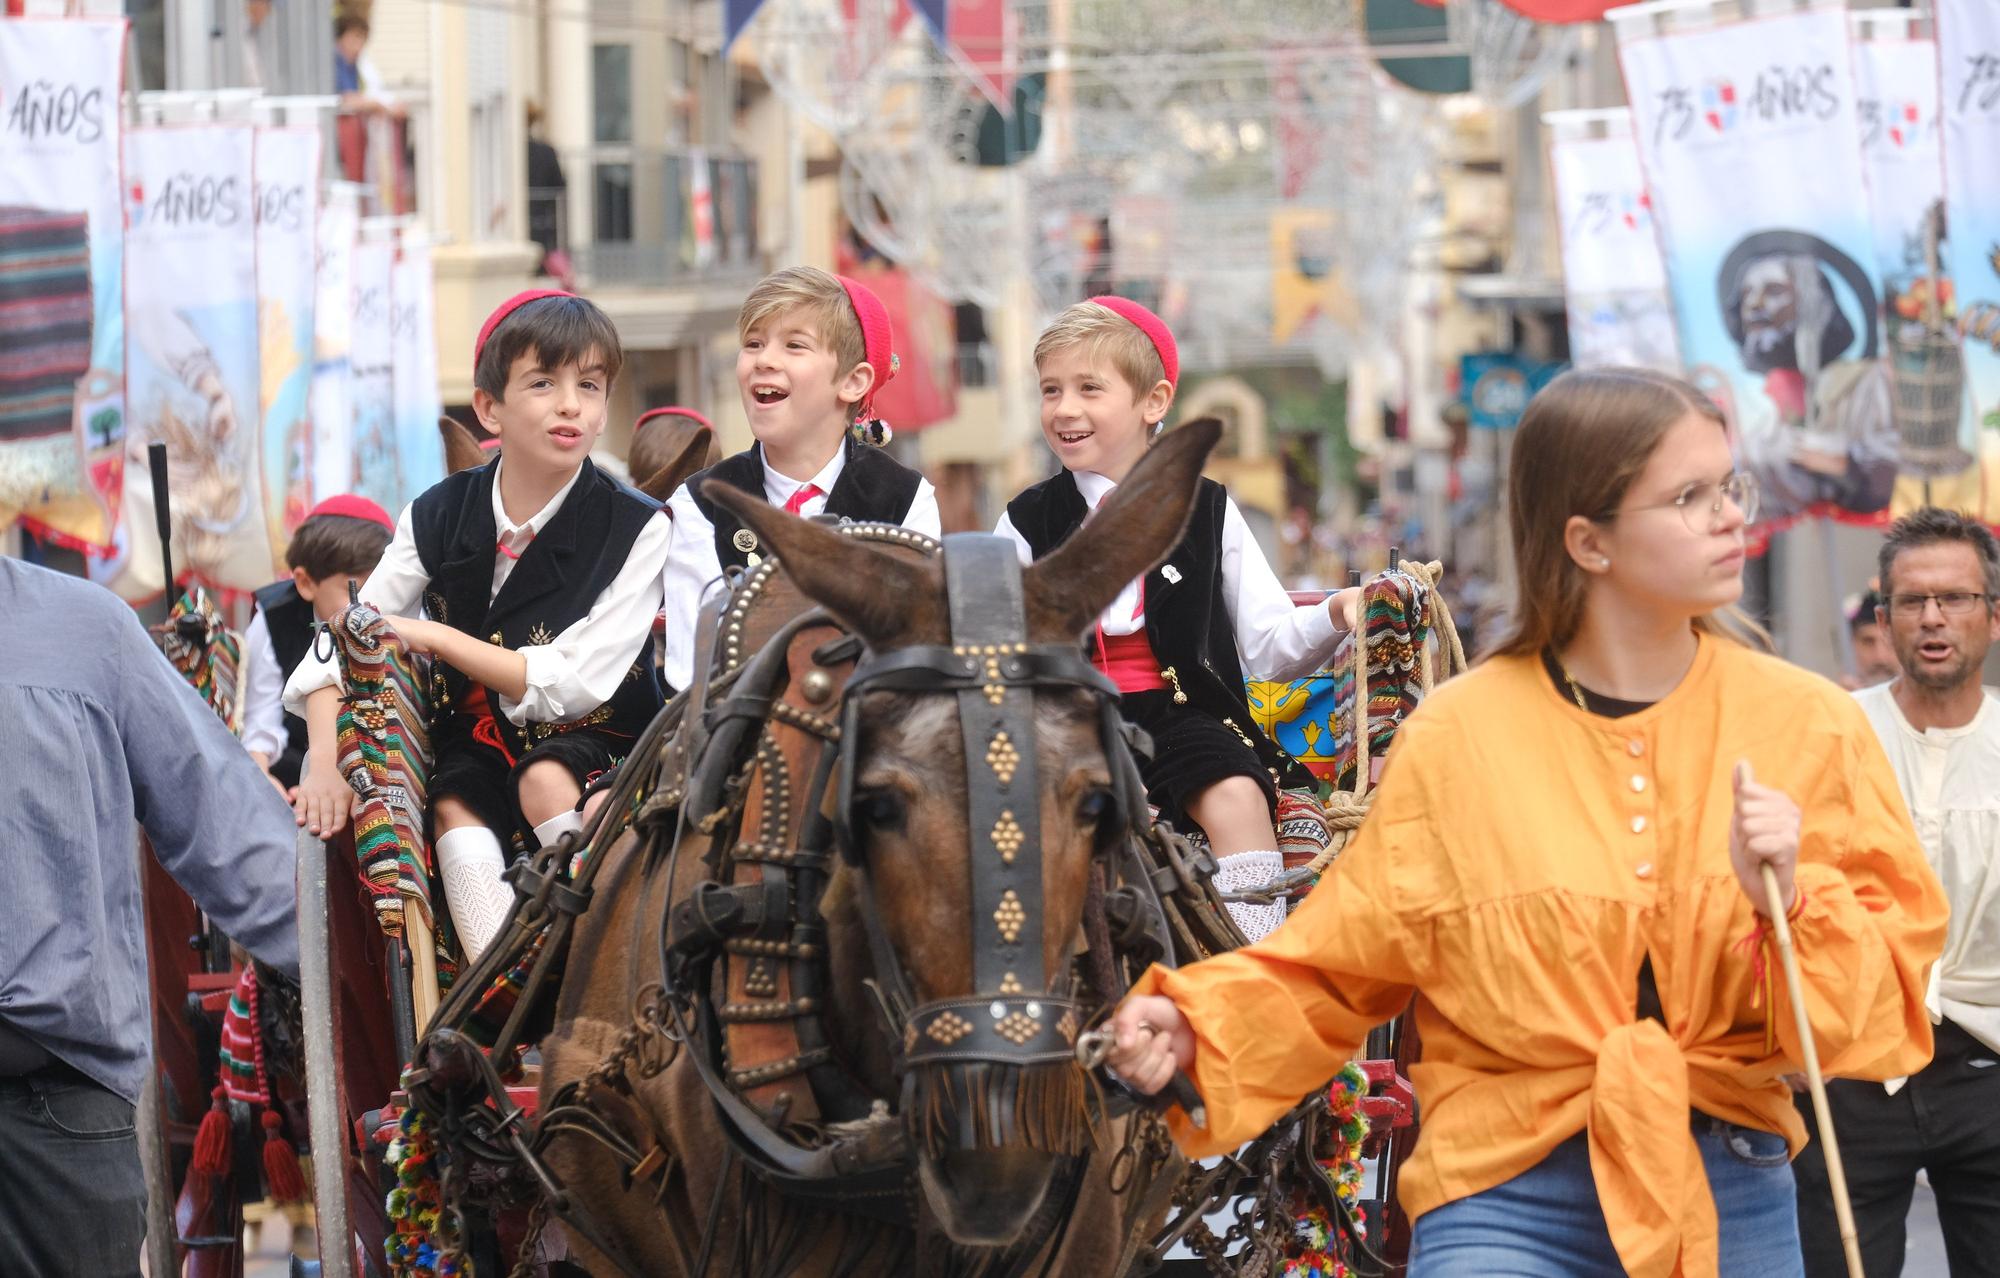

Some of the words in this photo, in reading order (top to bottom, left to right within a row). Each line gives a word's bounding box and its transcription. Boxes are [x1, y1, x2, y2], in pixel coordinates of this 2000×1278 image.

[6, 79, 103, 143] AÑOS
[1655, 84, 1695, 146] 75
[1747, 65, 1839, 121] AÑOS
[150, 173, 241, 228] AÑOS
